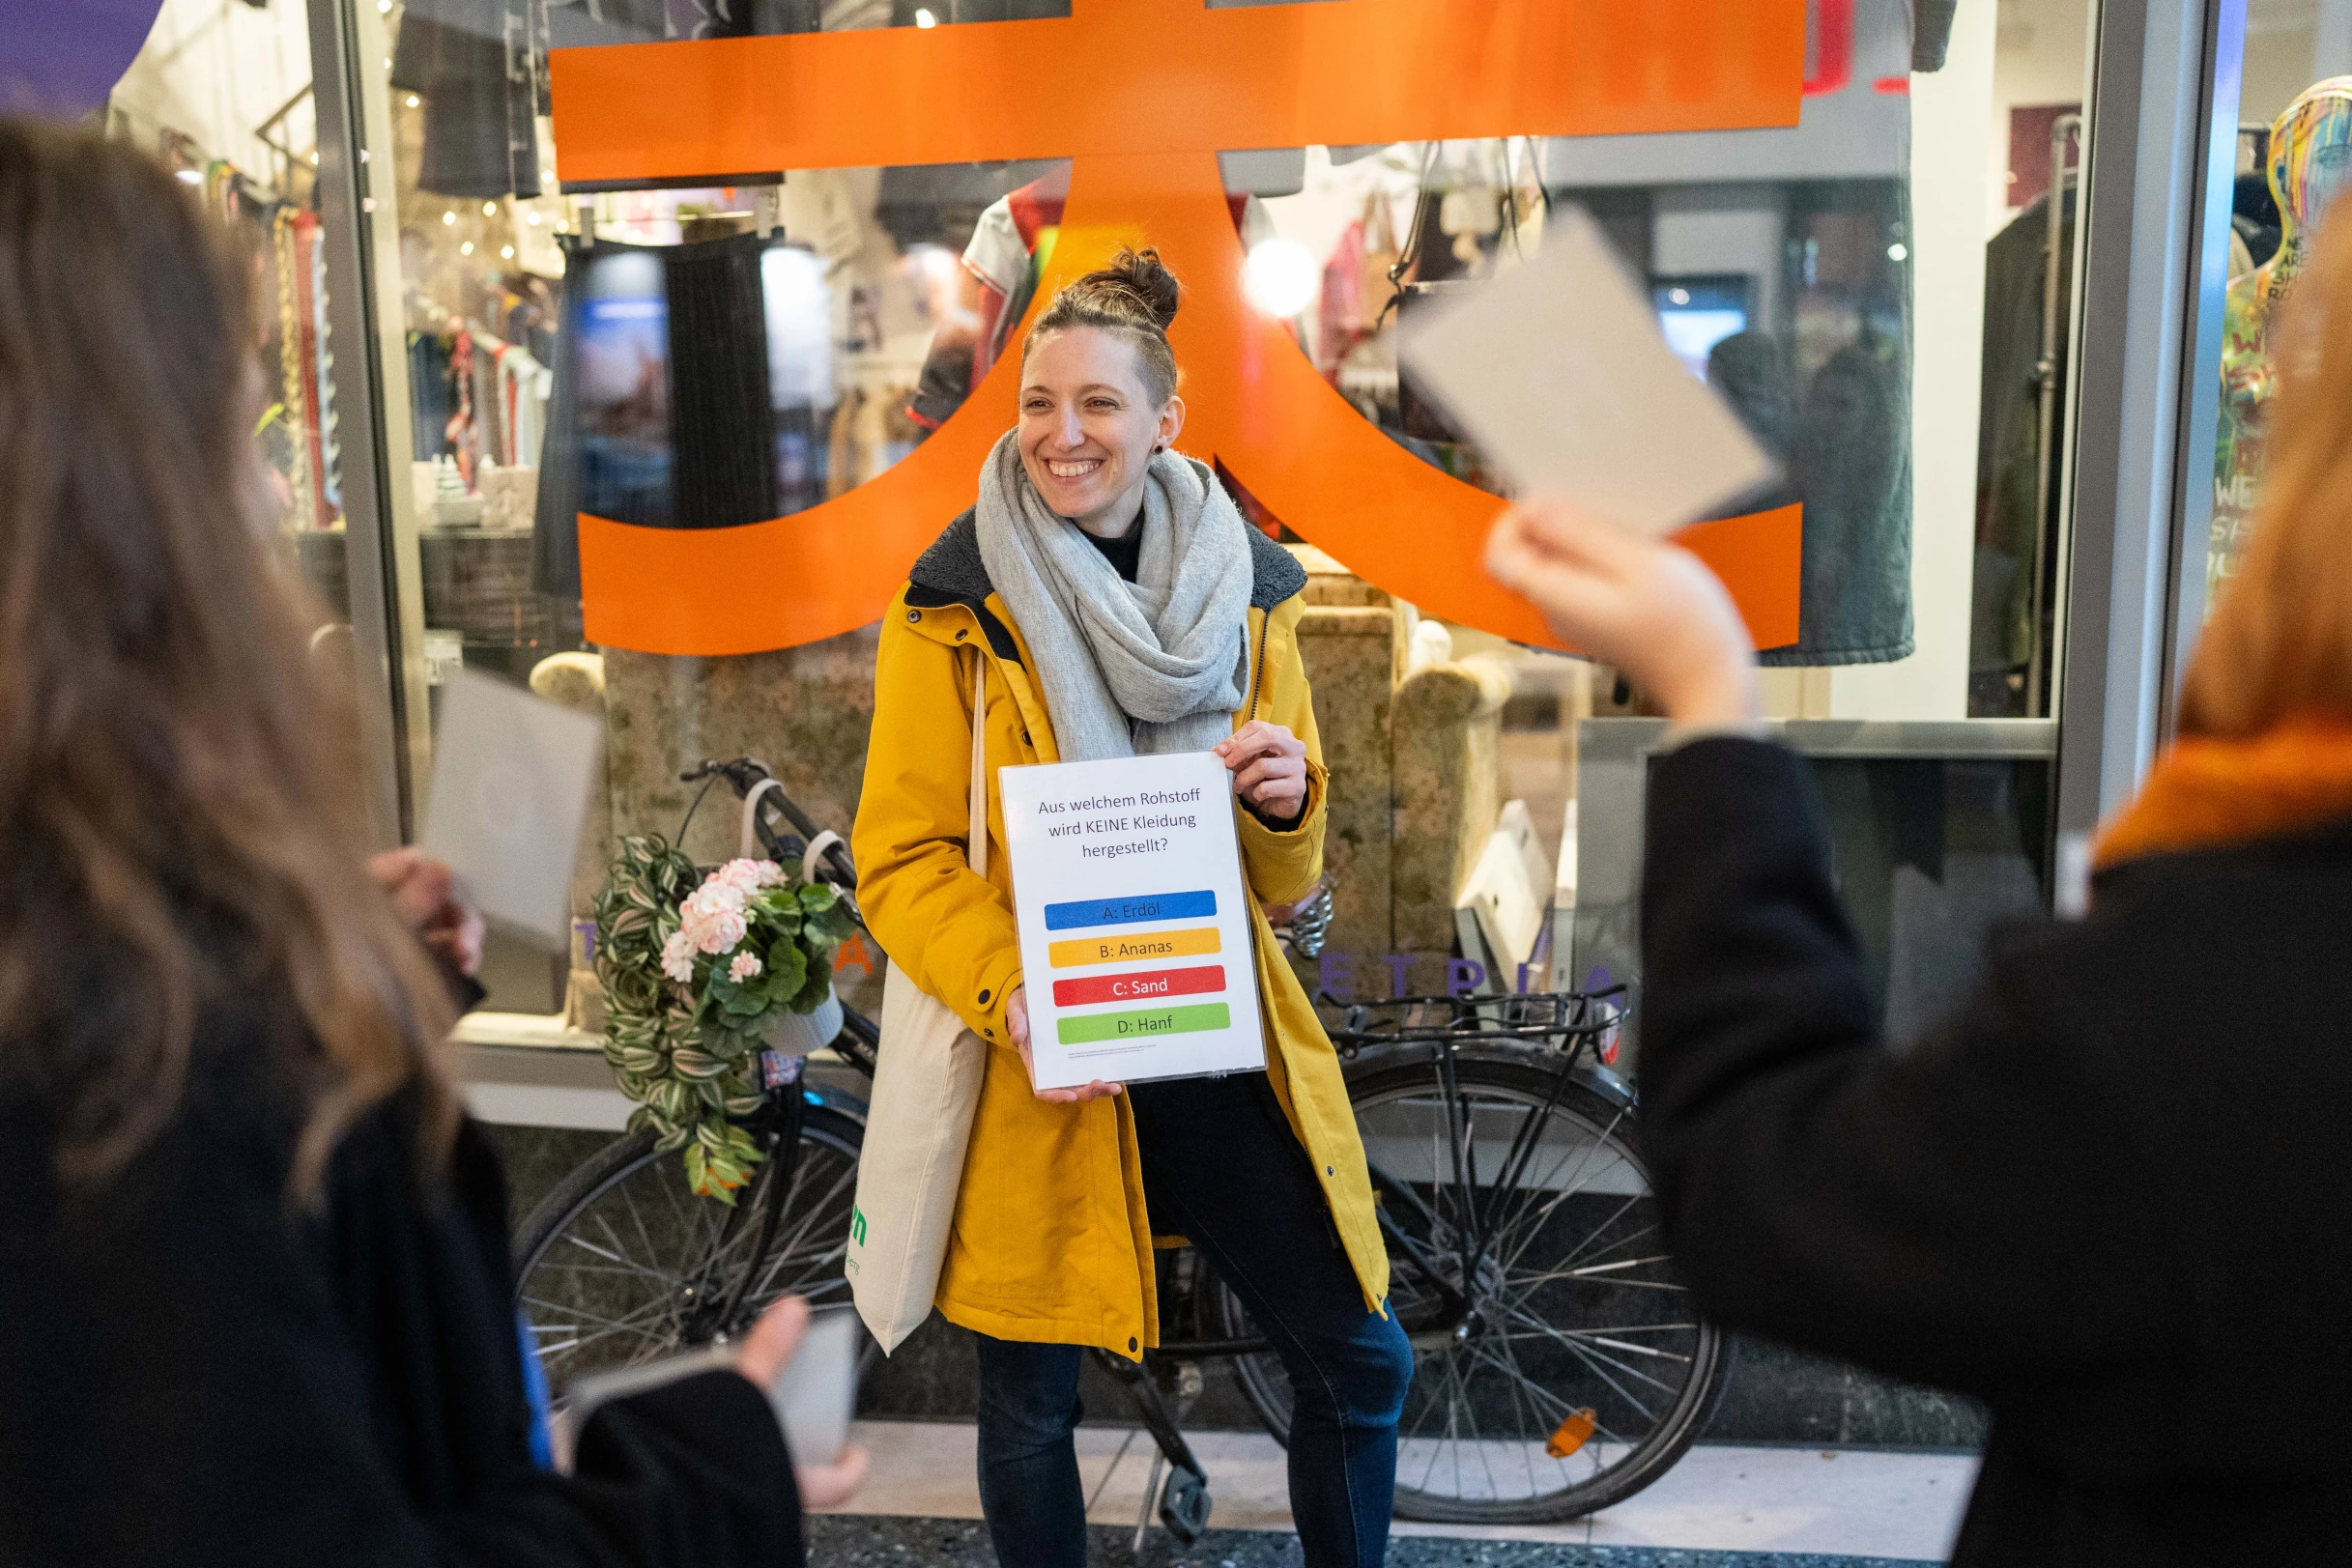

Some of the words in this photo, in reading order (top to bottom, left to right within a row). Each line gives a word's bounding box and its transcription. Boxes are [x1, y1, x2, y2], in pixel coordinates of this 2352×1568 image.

[1039, 801, 1066, 814] Aus
[1070, 795, 1136, 812] welchem
[1140, 787, 1201, 806] Rohstoff
[1048, 822, 1081, 837] wird
[1086, 817, 1129, 834] KEINE
[1133, 813, 1196, 831] Kleidung
[1082, 838, 1168, 859] hergestellt?
[1104, 907, 1118, 920] A:
[1123, 901, 1161, 918] Erdöl
[1100, 945, 1114, 958] B:
[1119, 941, 1173, 956] Ananas
[1112, 982, 1128, 996] C:
[1132, 977, 1168, 994] Sand
[1117, 1019, 1133, 1034] D:
[1137, 1014, 1173, 1032] Hanf
